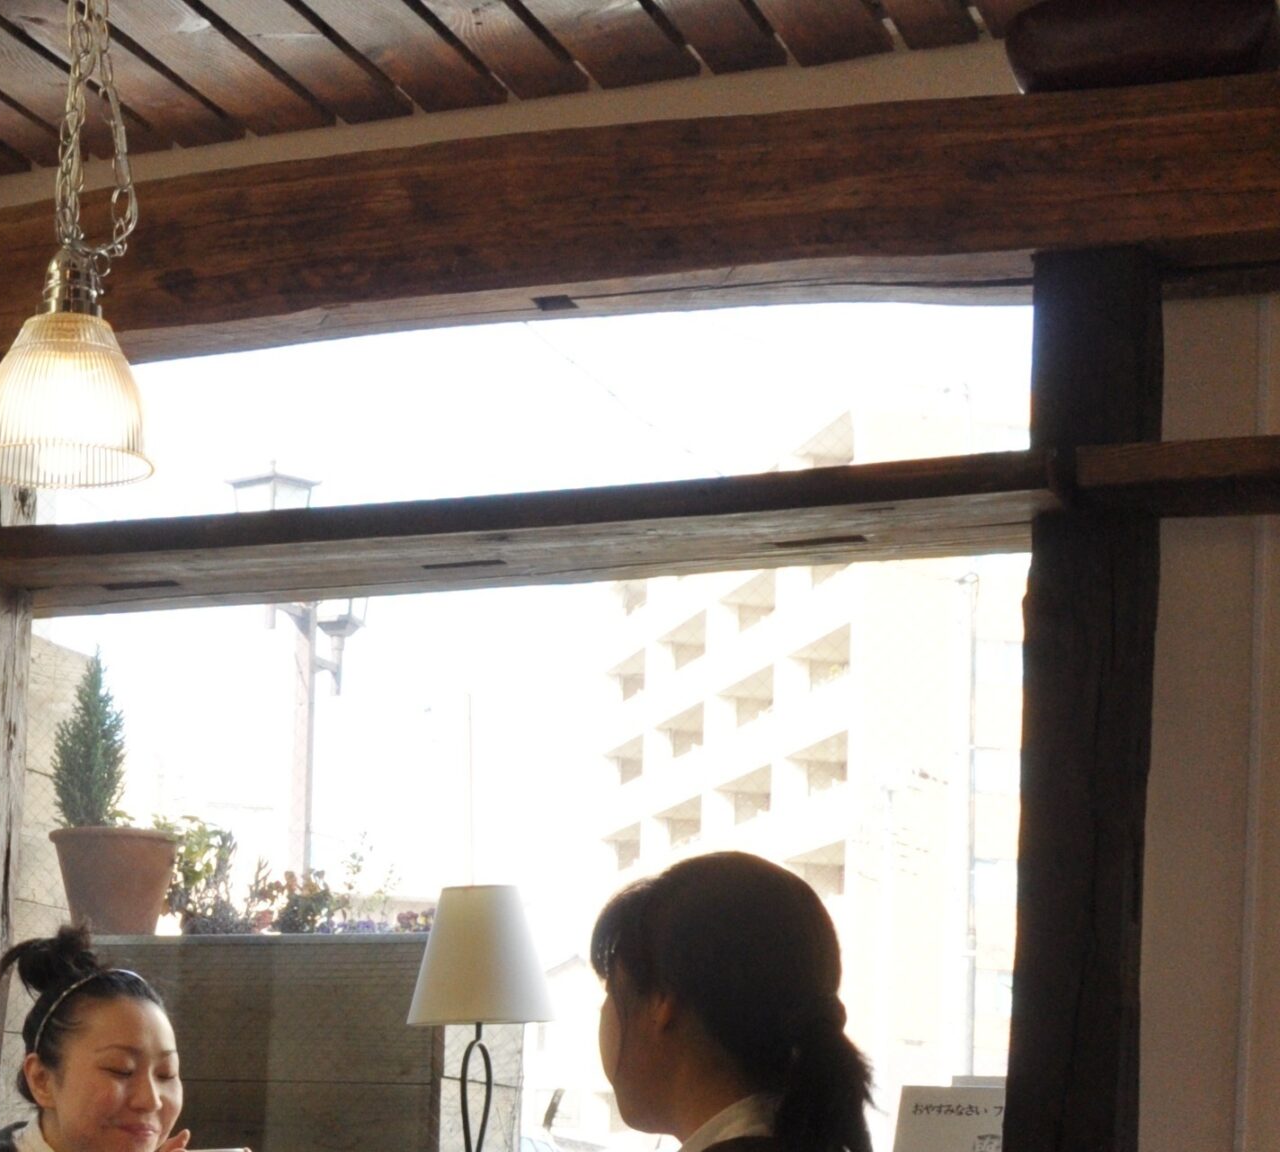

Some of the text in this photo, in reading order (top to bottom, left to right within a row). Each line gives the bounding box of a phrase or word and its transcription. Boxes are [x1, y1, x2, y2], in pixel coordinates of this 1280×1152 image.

[912, 1103, 988, 1116] おやすみなさい
